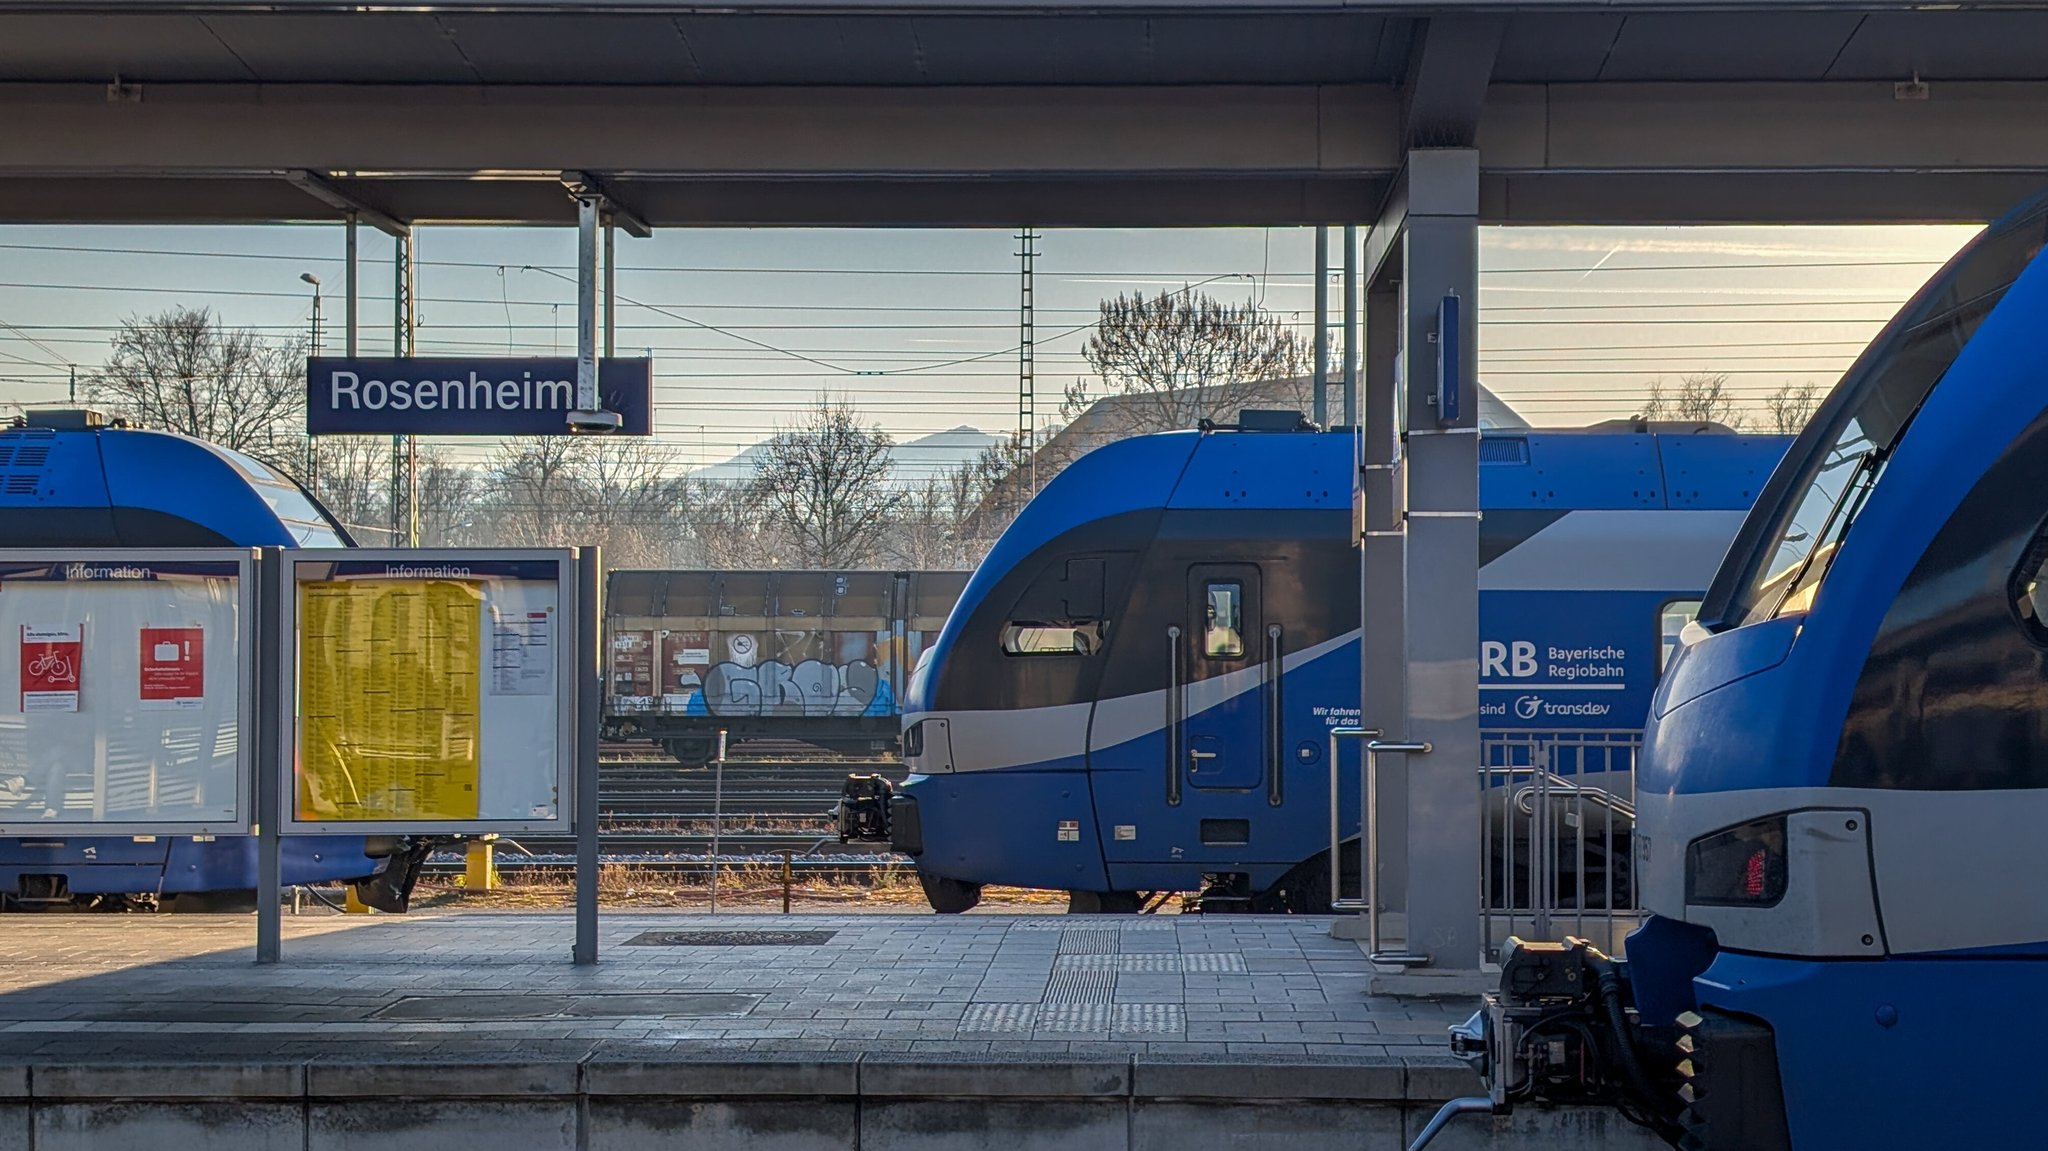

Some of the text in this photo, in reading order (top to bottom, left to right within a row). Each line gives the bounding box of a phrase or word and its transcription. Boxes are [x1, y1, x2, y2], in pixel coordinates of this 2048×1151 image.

[331, 371, 573, 410] Rosenheim
[66, 565, 151, 579] Information
[385, 564, 470, 578] Information
[1478, 641, 1539, 677] RB
[1548, 646, 1625, 662] Bayerische
[1548, 663, 1624, 680] Regiobahn
[1312, 707, 1361, 716] Wir fahren
[1480, 702, 1611, 715] sind transdev
[1325, 716, 1359, 725] für das
